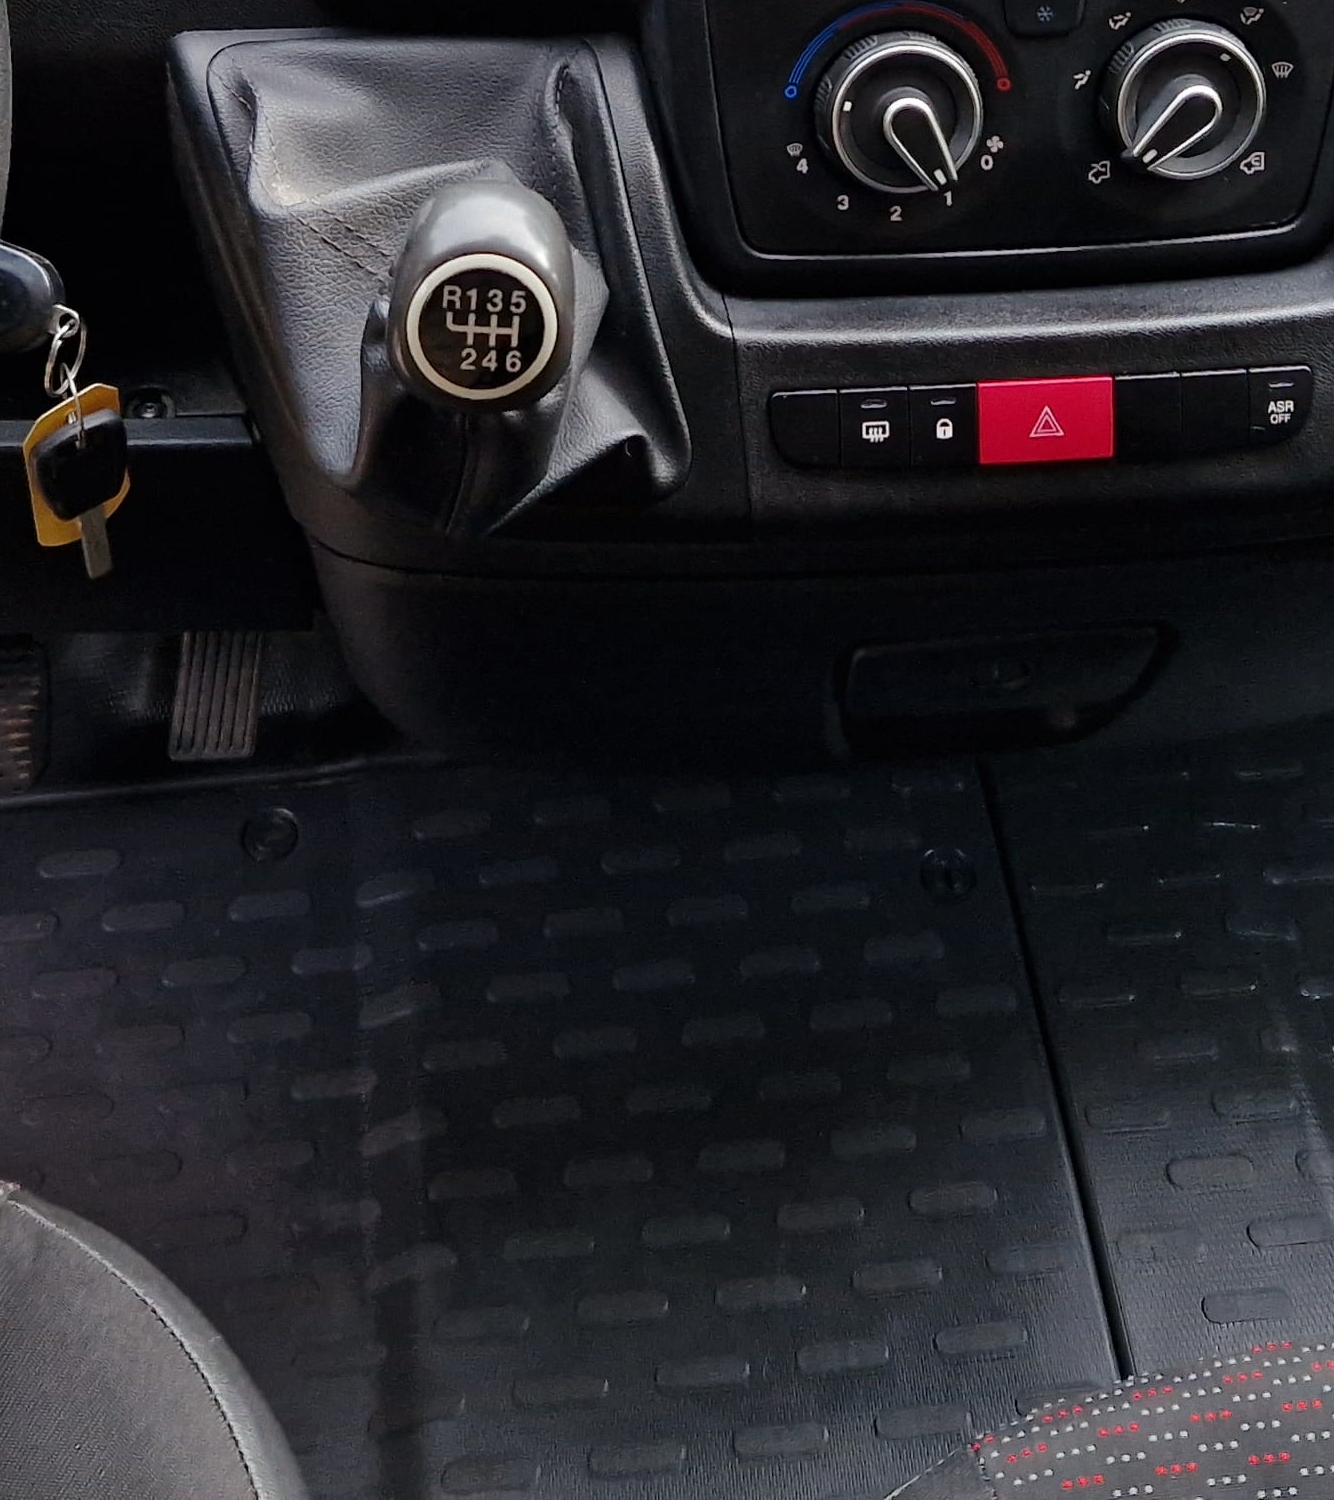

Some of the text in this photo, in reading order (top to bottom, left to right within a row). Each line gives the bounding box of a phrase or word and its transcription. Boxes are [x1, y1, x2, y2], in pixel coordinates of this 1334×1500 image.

[796, 158, 809, 174] 4
[980, 155, 994, 170] 0
[836, 195, 850, 211] 3
[943, 191, 953, 207] 1
[889, 205, 902, 222] 2
[1267, 399, 1295, 414] ASR
[1269, 413, 1292, 425] OFF
